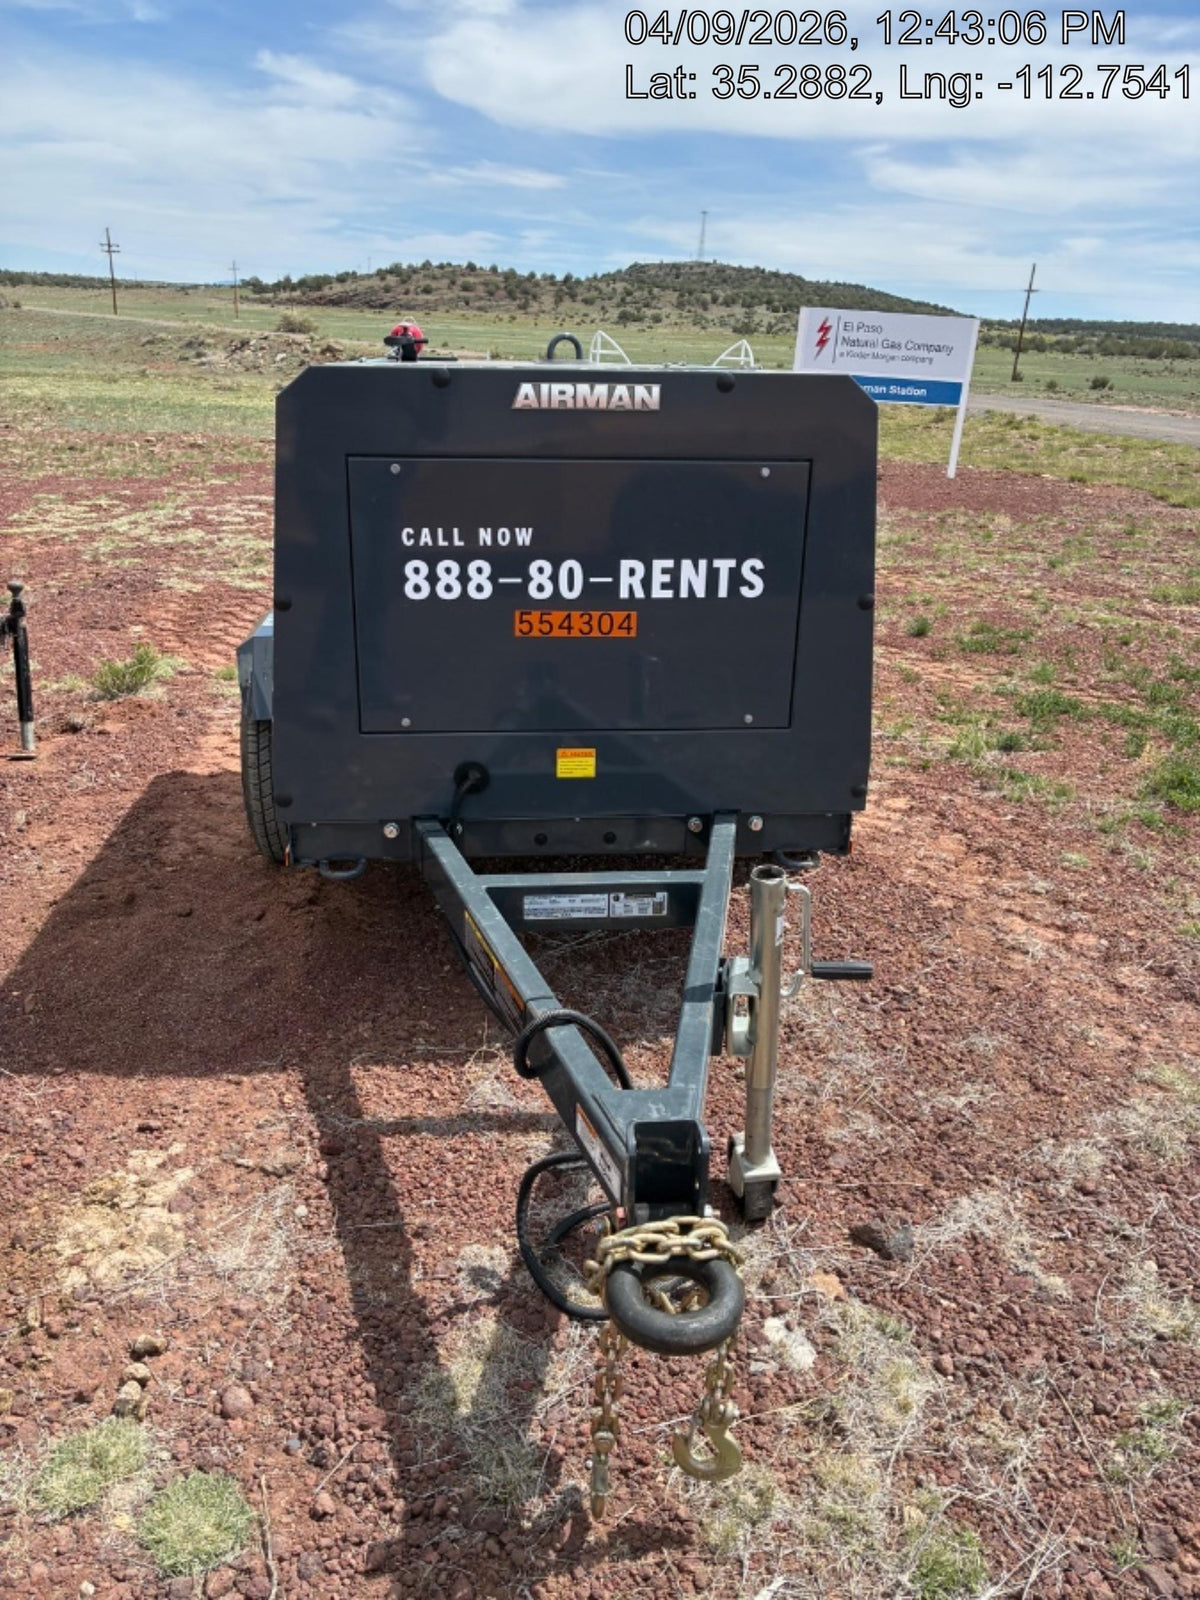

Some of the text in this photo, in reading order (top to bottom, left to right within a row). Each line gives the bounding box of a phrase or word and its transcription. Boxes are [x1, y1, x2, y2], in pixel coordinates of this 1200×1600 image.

[843, 321, 883, 334] El Paso
[840, 335, 954, 356] Natural Gas Company
[511, 382, 662, 411] AIRMAN
[863, 384, 928, 397] man Station
[401, 526, 534, 547] CALL NOW
[517, 610, 635, 637] 554304
